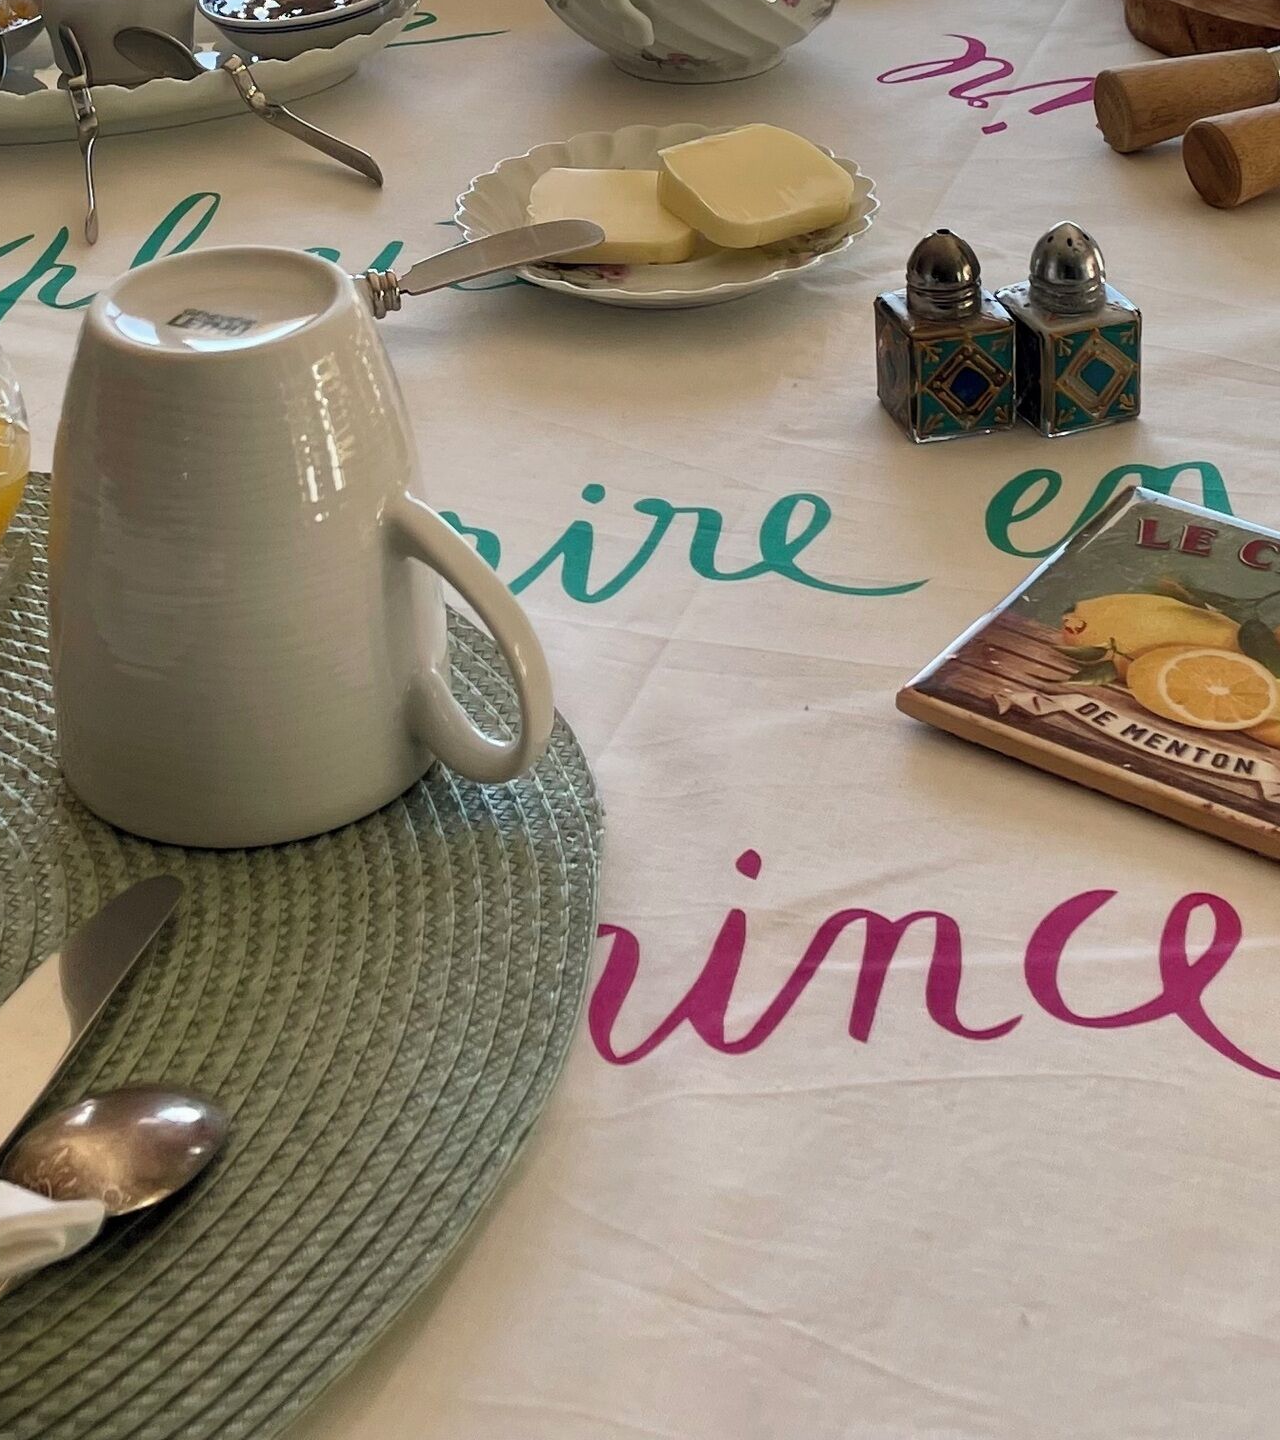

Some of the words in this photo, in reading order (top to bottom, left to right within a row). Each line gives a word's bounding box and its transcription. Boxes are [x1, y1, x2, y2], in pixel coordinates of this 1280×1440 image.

[1136, 516, 1219, 558] LE
[1074, 702, 1119, 727] DE
[1120, 722, 1255, 775] MENTON
